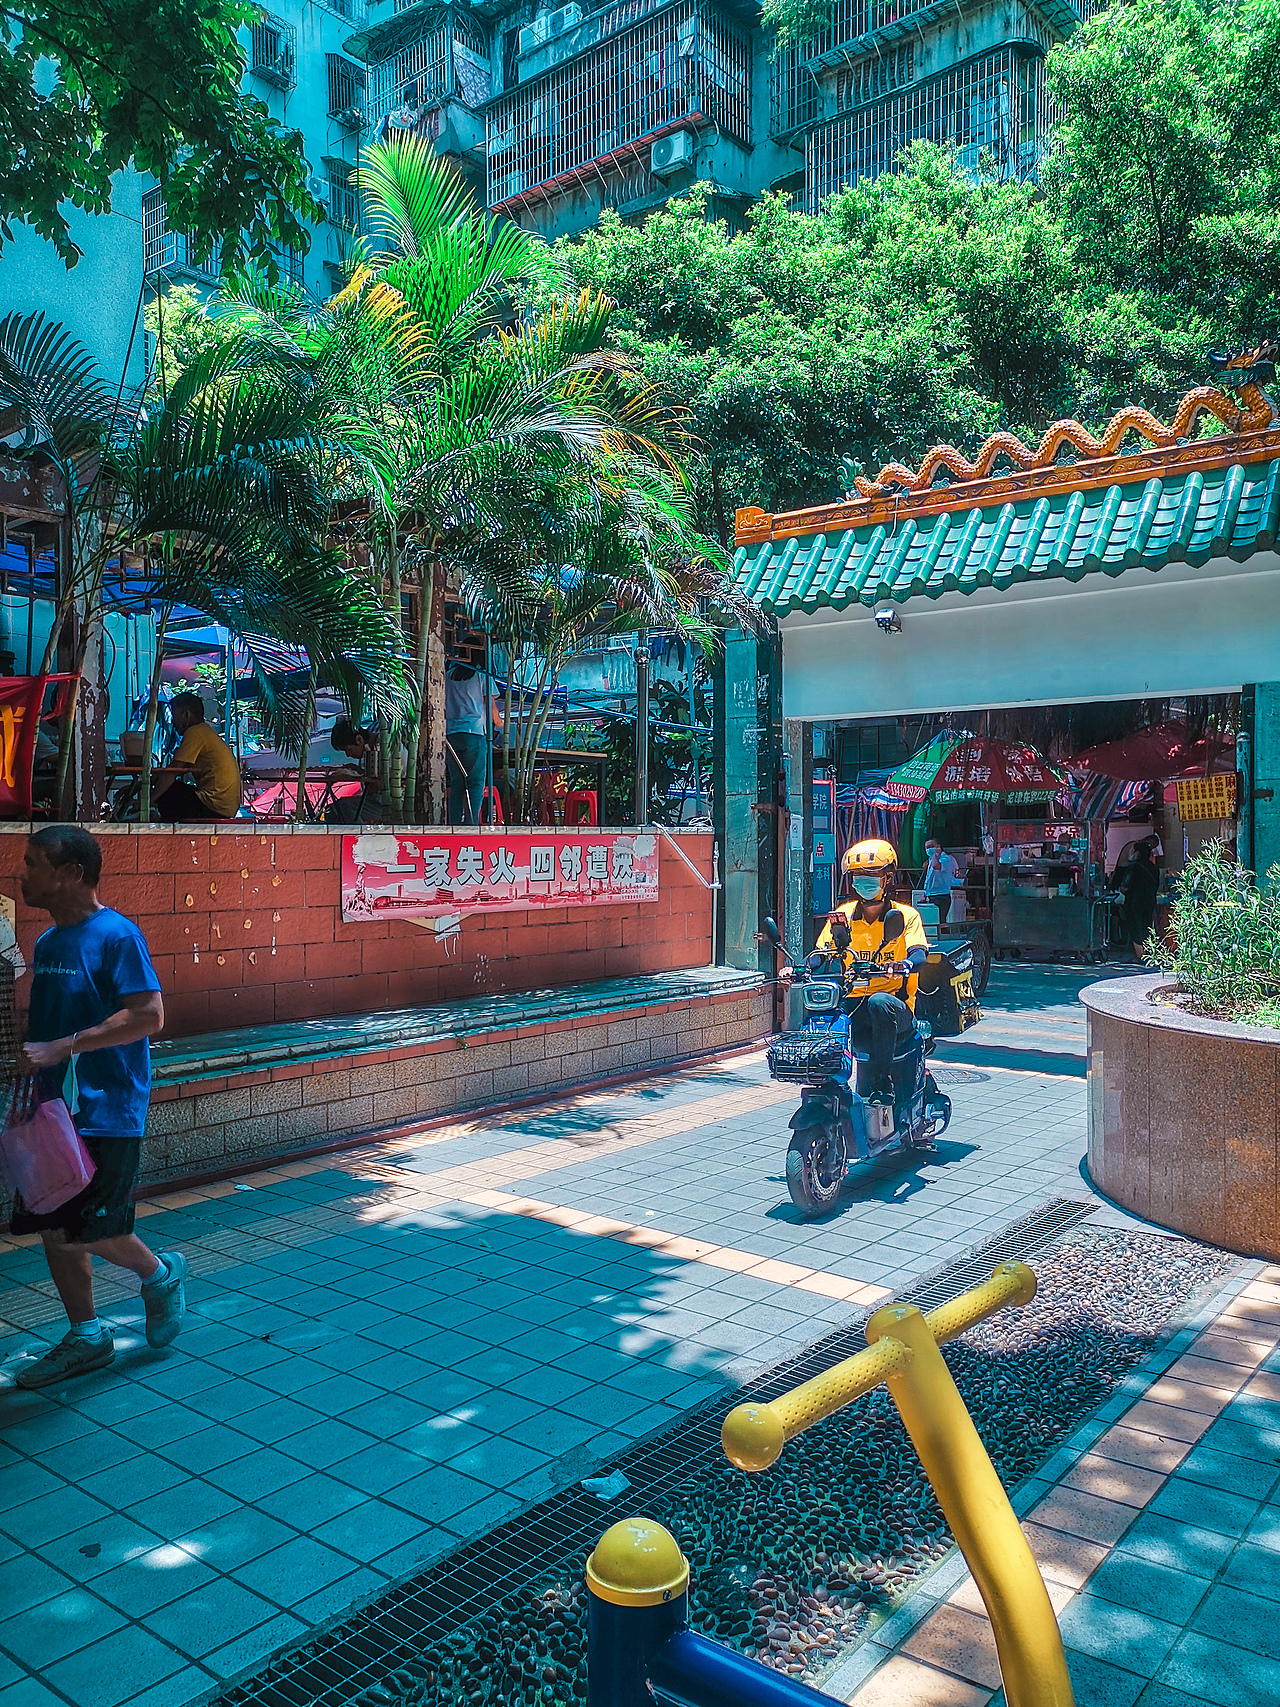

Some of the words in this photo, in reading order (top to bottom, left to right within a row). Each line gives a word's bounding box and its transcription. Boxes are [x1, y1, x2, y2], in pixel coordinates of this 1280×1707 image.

[386, 846, 516, 887] 一家失火
[530, 844, 634, 882] 四邻遭殃
[816, 867, 830, 881] 本科
